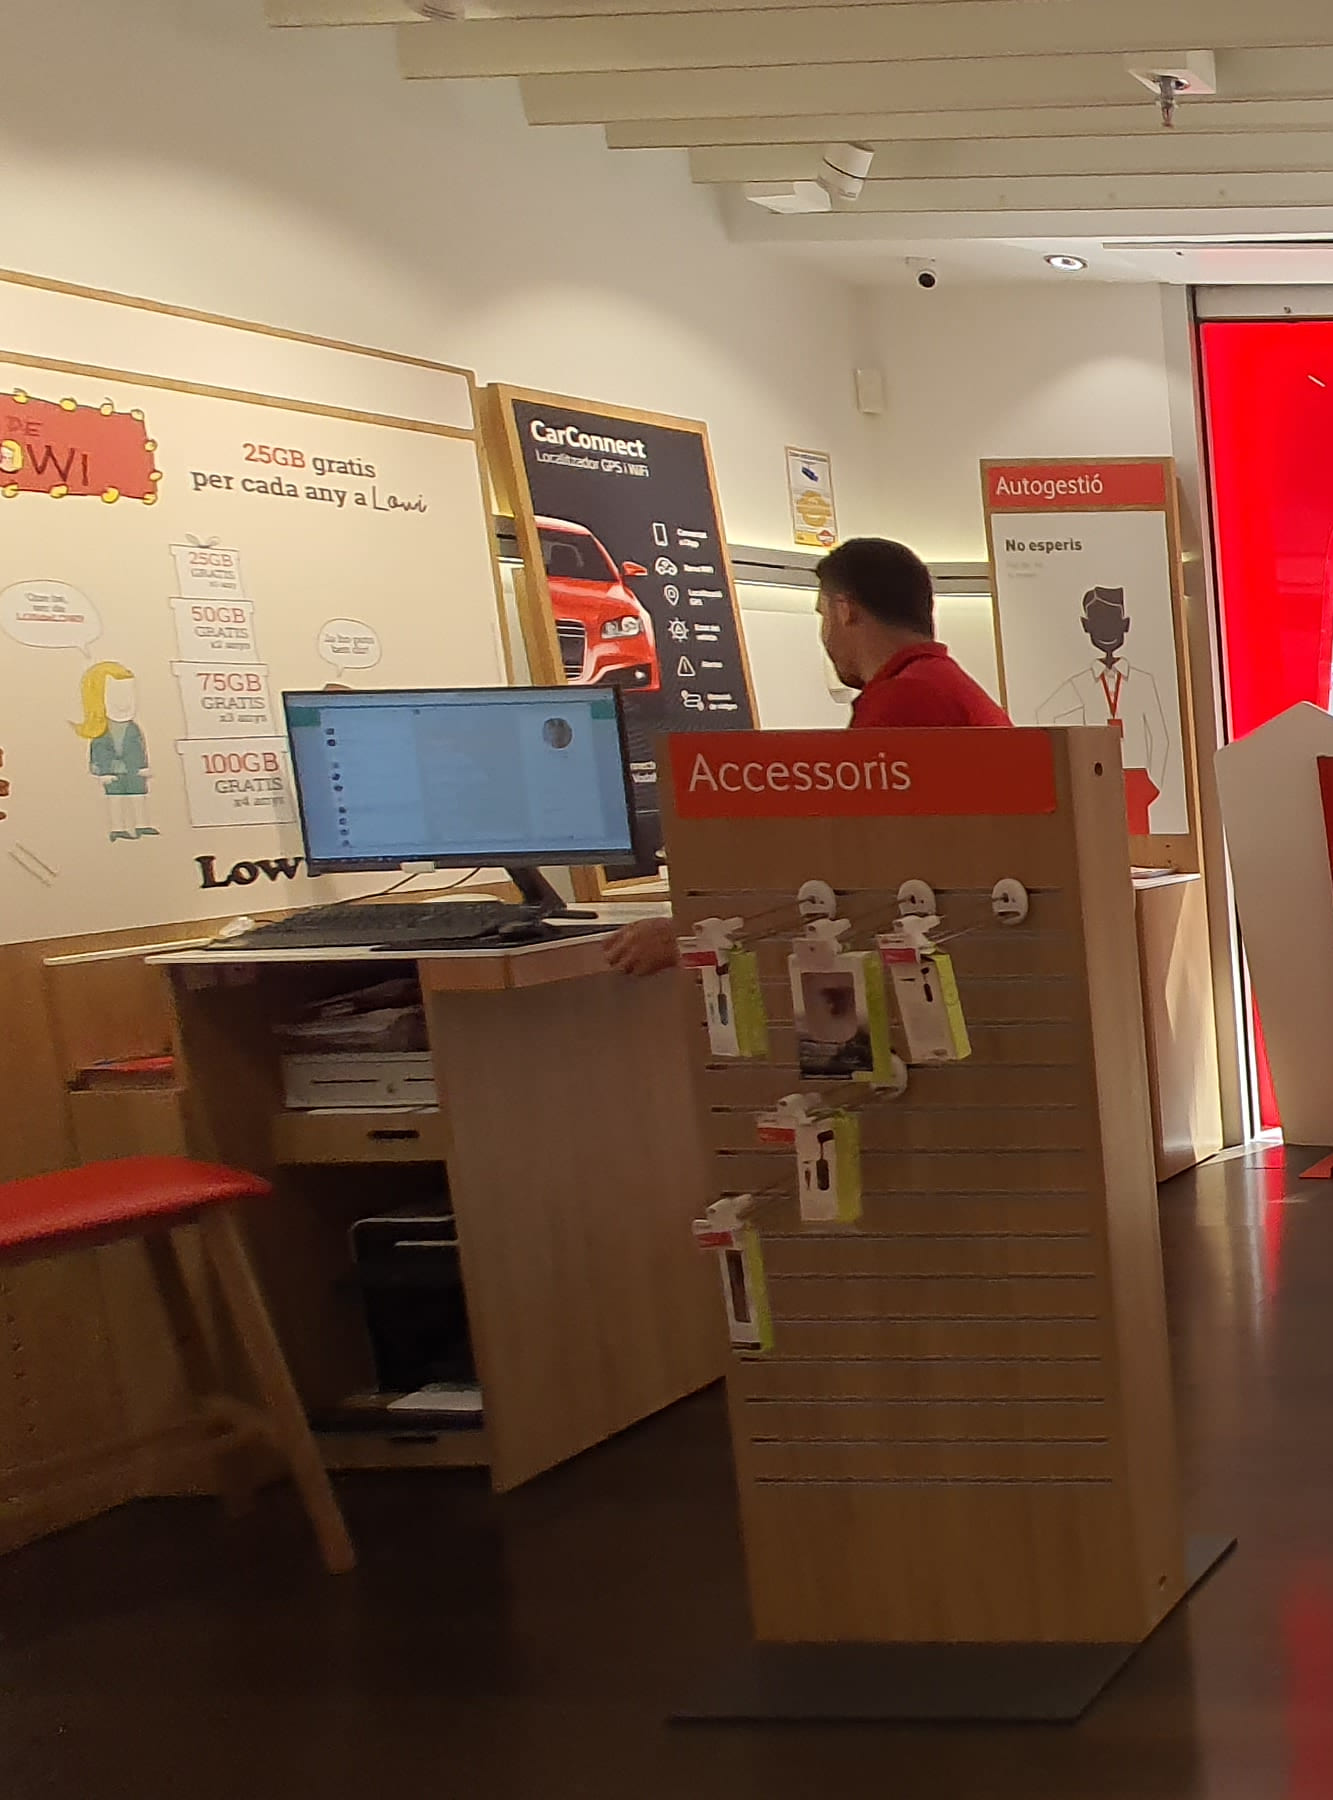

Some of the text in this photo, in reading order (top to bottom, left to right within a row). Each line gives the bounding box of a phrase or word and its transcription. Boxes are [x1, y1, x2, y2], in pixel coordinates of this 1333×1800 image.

[530, 420, 648, 459] CarConnect
[242, 443, 377, 478] 25GB gratis
[600, 458, 622, 473] GPS
[190, 471, 234, 490] per
[241, 477, 299, 498] cada
[306, 485, 347, 507] any
[354, 493, 368, 506] a
[995, 472, 1104, 500] Autogestió
[1005, 538, 1083, 554] No esperis
[189, 552, 234, 567] 25GB
[190, 569, 236, 580] GRATIS
[191, 606, 246, 623] 50GB
[194, 626, 248, 639] GRATIS
[197, 673, 262, 692] 75GB
[201, 697, 265, 710] GRATIS
[202, 752, 280, 774] 100GB
[688, 752, 912, 793] Accessoris
[215, 778, 283, 794] GRATIS
